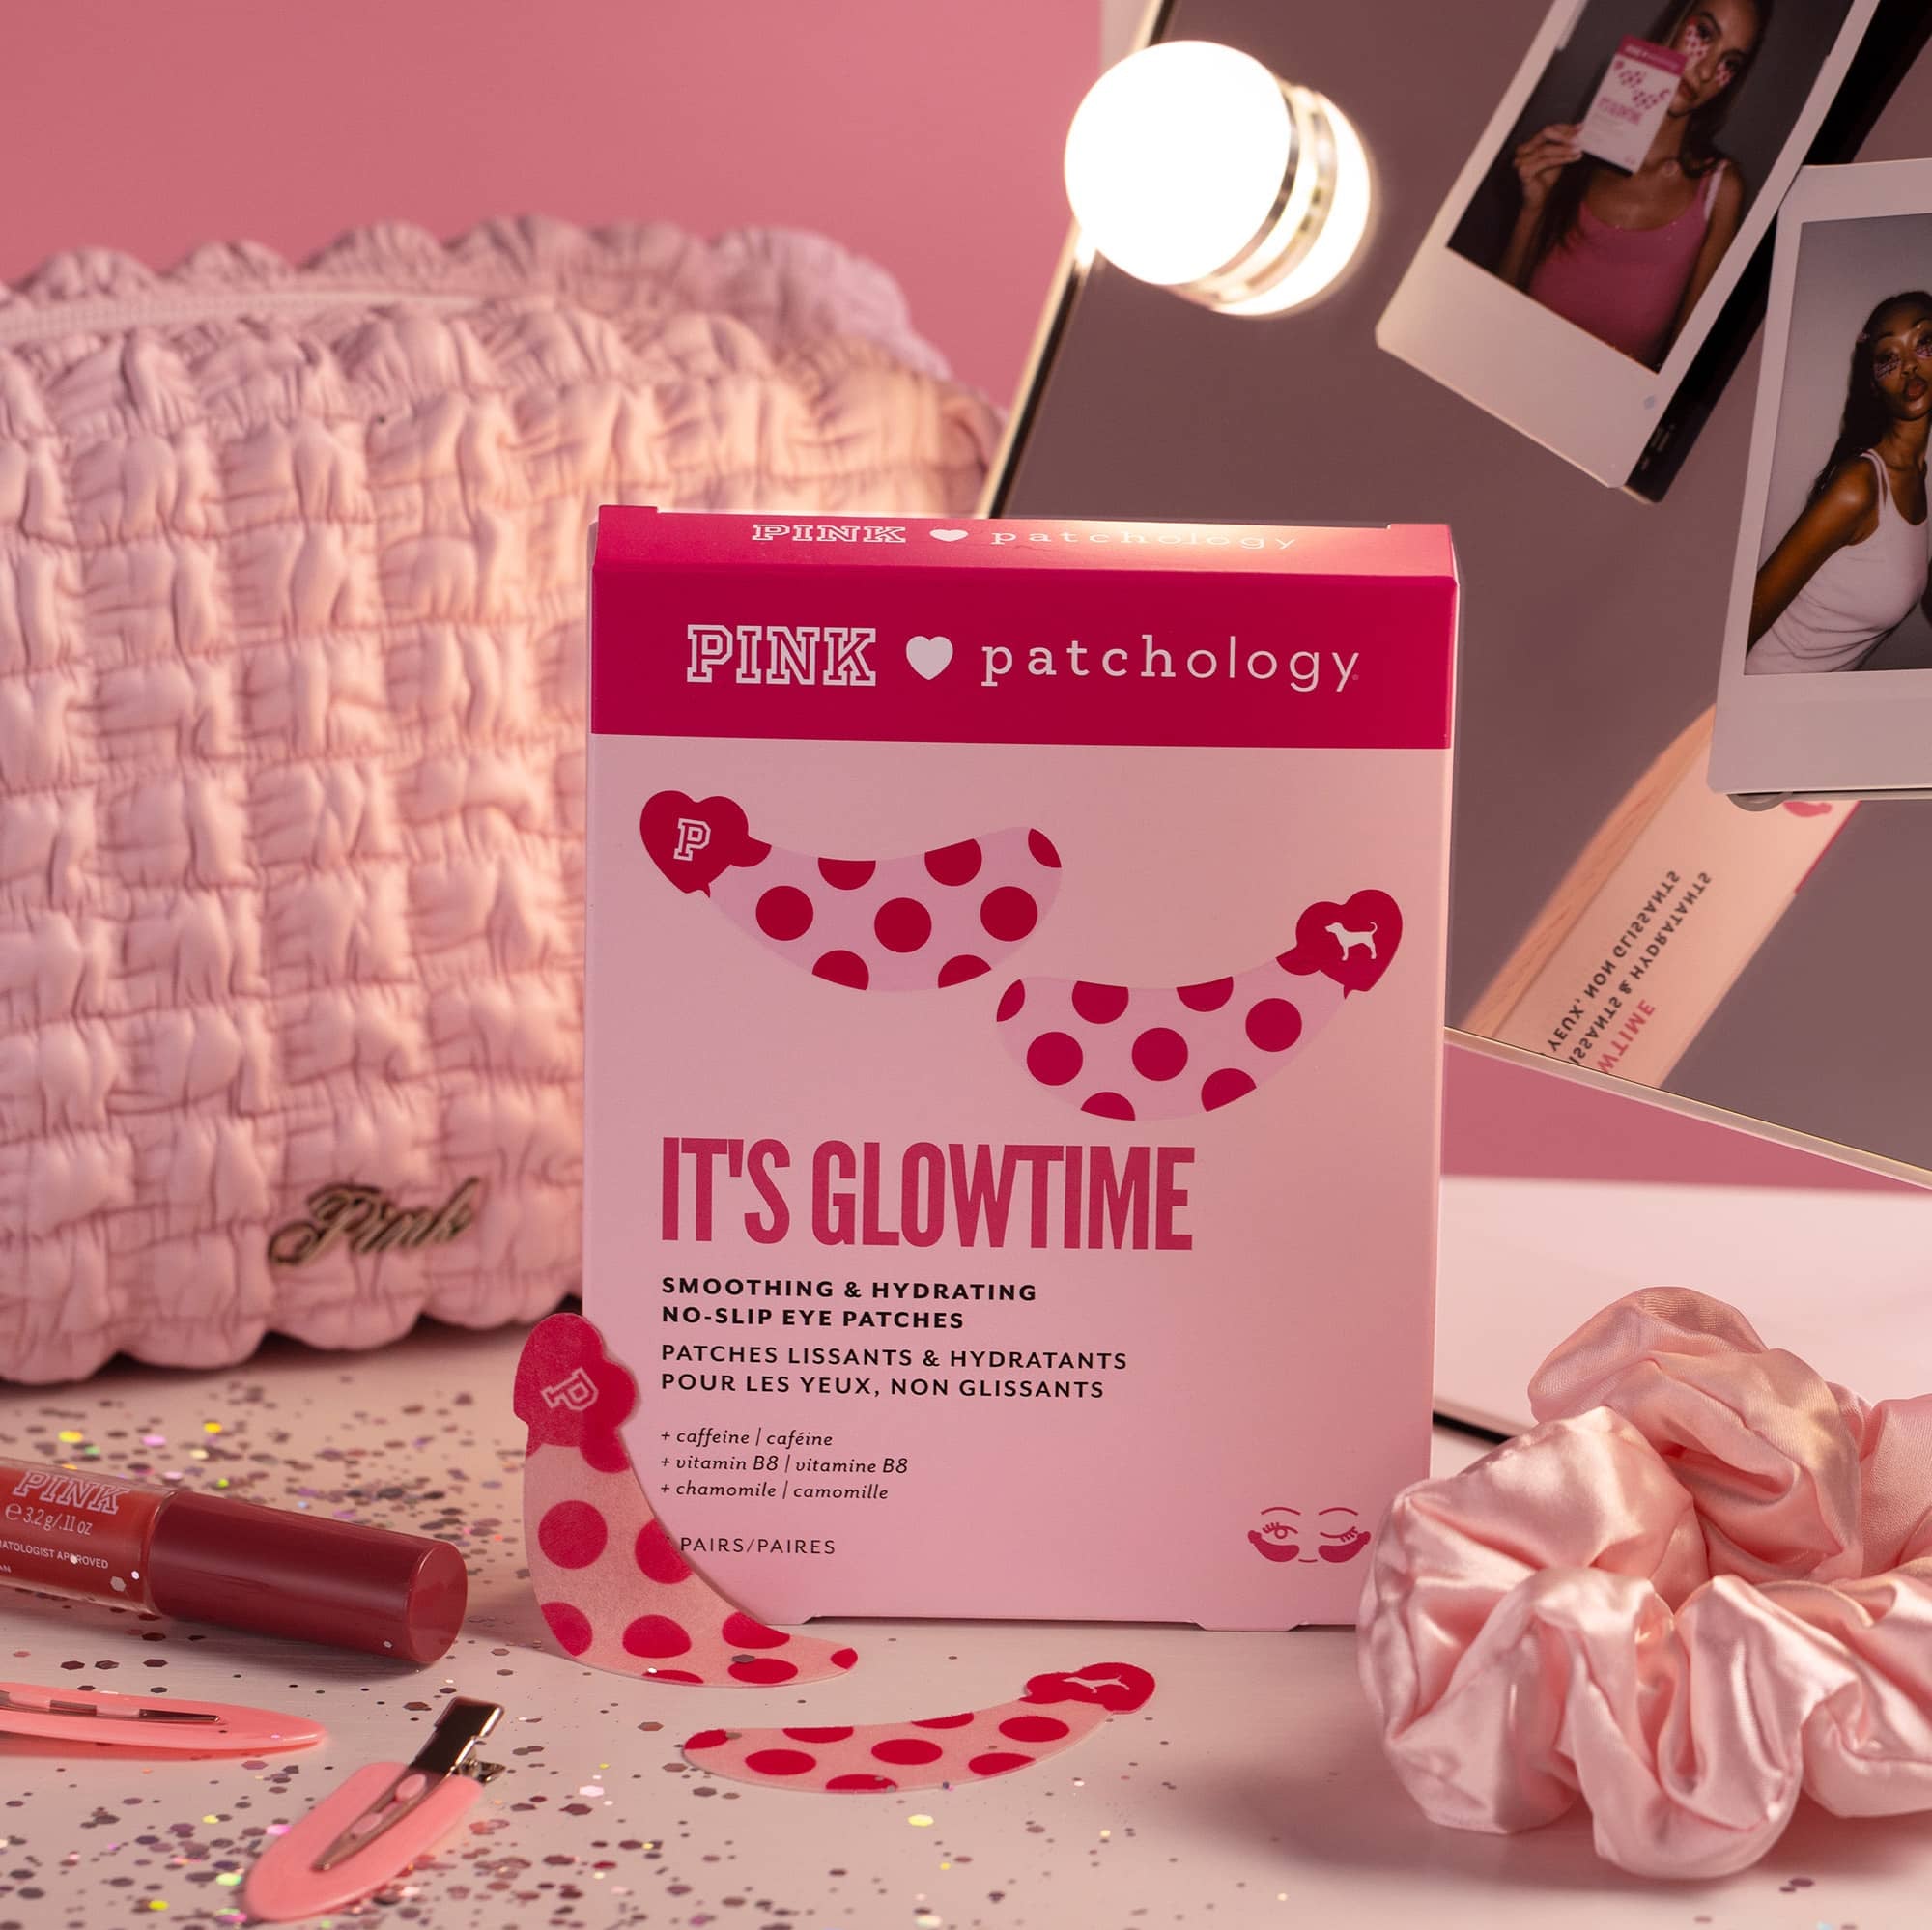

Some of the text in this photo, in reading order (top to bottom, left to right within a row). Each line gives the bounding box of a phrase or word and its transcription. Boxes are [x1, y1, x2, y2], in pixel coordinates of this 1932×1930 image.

[753, 525, 1295, 550] PINK patchology
[687, 624, 1359, 692] PINK patchology
[673, 818, 711, 861] P
[662, 1137, 1195, 1250] IT'S GLOWTIME
[268, 1176, 480, 1266] Pink
[662, 1277, 1037, 1302] SMOOTHING & HYDRATING
[663, 1306, 964, 1330] NO-SLIP EYE PATCHES
[663, 1345, 1127, 1370] PATCHES LISSANTS & HYDRATANTS
[541, 1367, 599, 1410] P
[662, 1374, 1103, 1399] POUR LES YEUX, NON GLISSANTS
[676, 1428, 750, 1448] caffeine
[766, 1429, 834, 1450] caféine
[676, 1456, 747, 1471] vitamin
[753, 1454, 779, 1471] B8
[796, 1458, 877, 1474] vitamine
[883, 1458, 908, 1474] B8
[12, 1470, 131, 1515] PINK
[676, 1480, 777, 1498] chamomile
[793, 1484, 889, 1500] camomille
[77, 1521, 93, 1536] oz
[0, 1539, 55, 1558] ATOLOGIST
[680, 1537, 836, 1555] PAIRS/PAIRES
